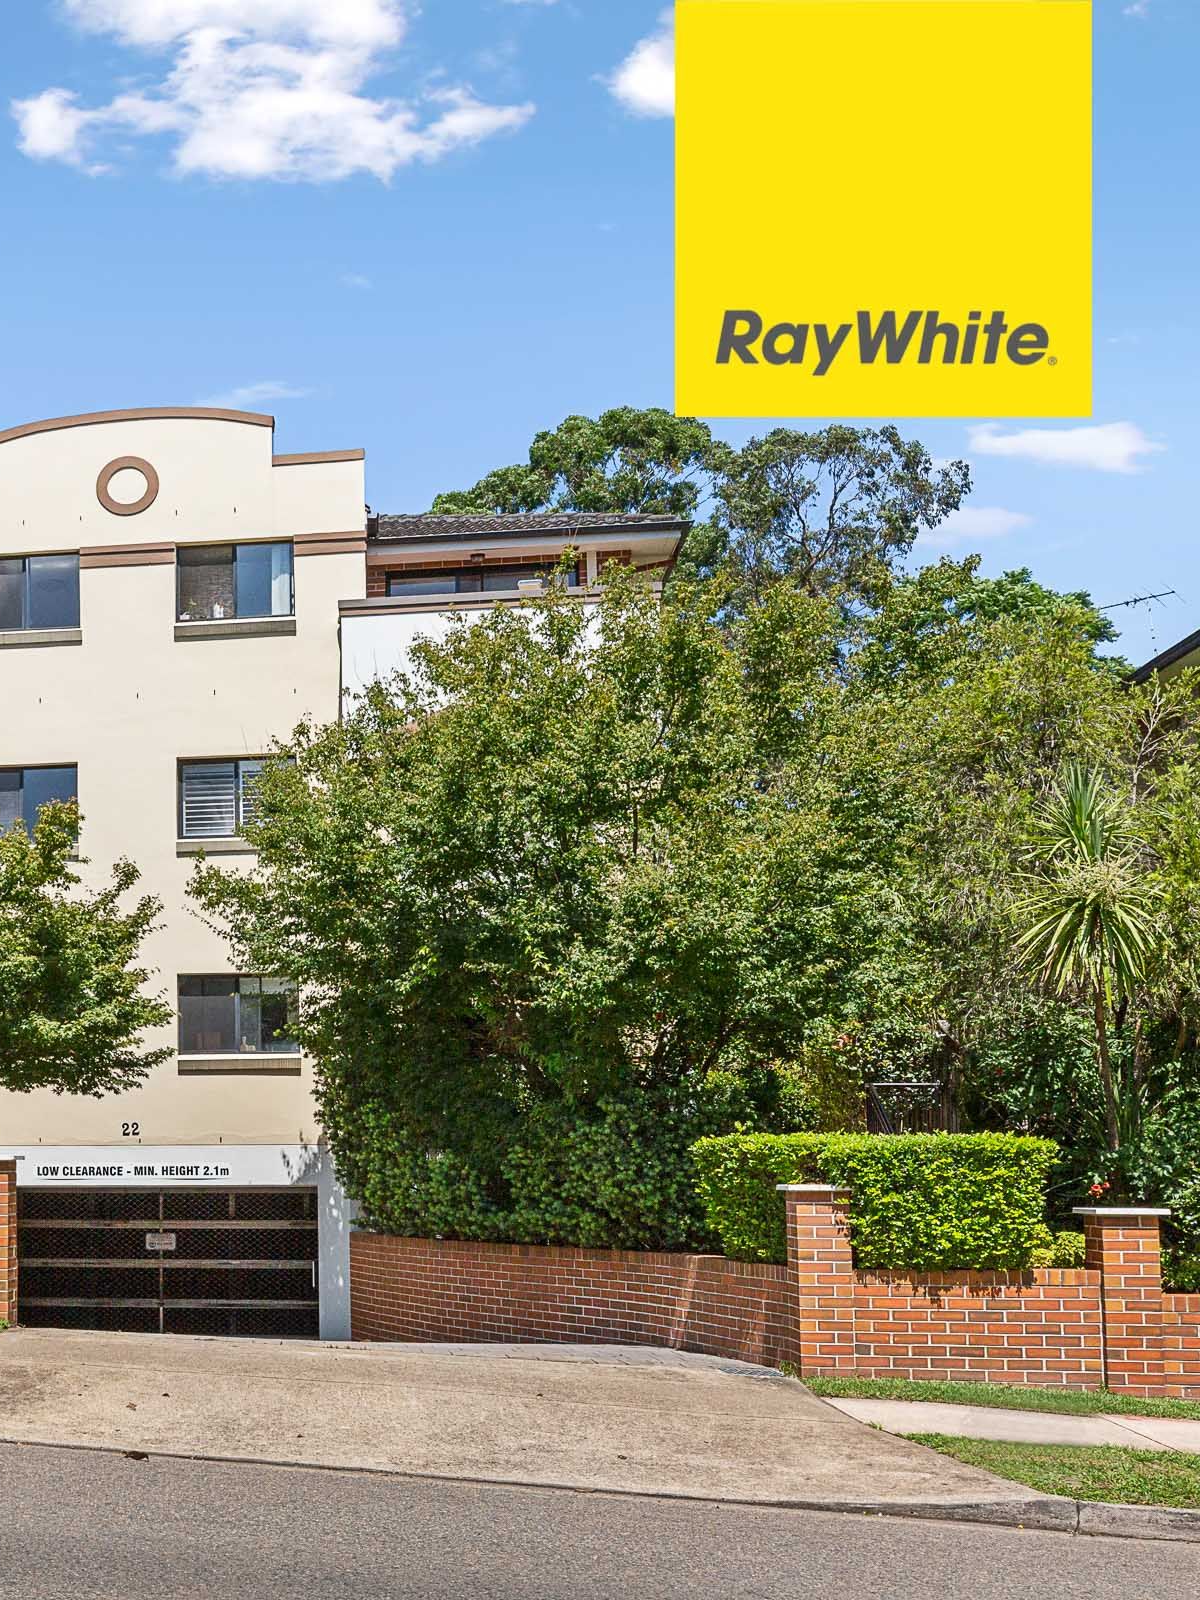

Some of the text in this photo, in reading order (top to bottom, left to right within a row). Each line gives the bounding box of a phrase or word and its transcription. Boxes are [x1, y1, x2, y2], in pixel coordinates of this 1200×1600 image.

[121, 1122, 141, 1137] 22
[36, 1166, 60, 1177] LOW
[62, 1166, 124, 1177] CLEARANCE
[133, 1165, 158, 1176] MIN.
[161, 1165, 201, 1176] HEIGHT
[203, 1165, 230, 1176] 2.1m
